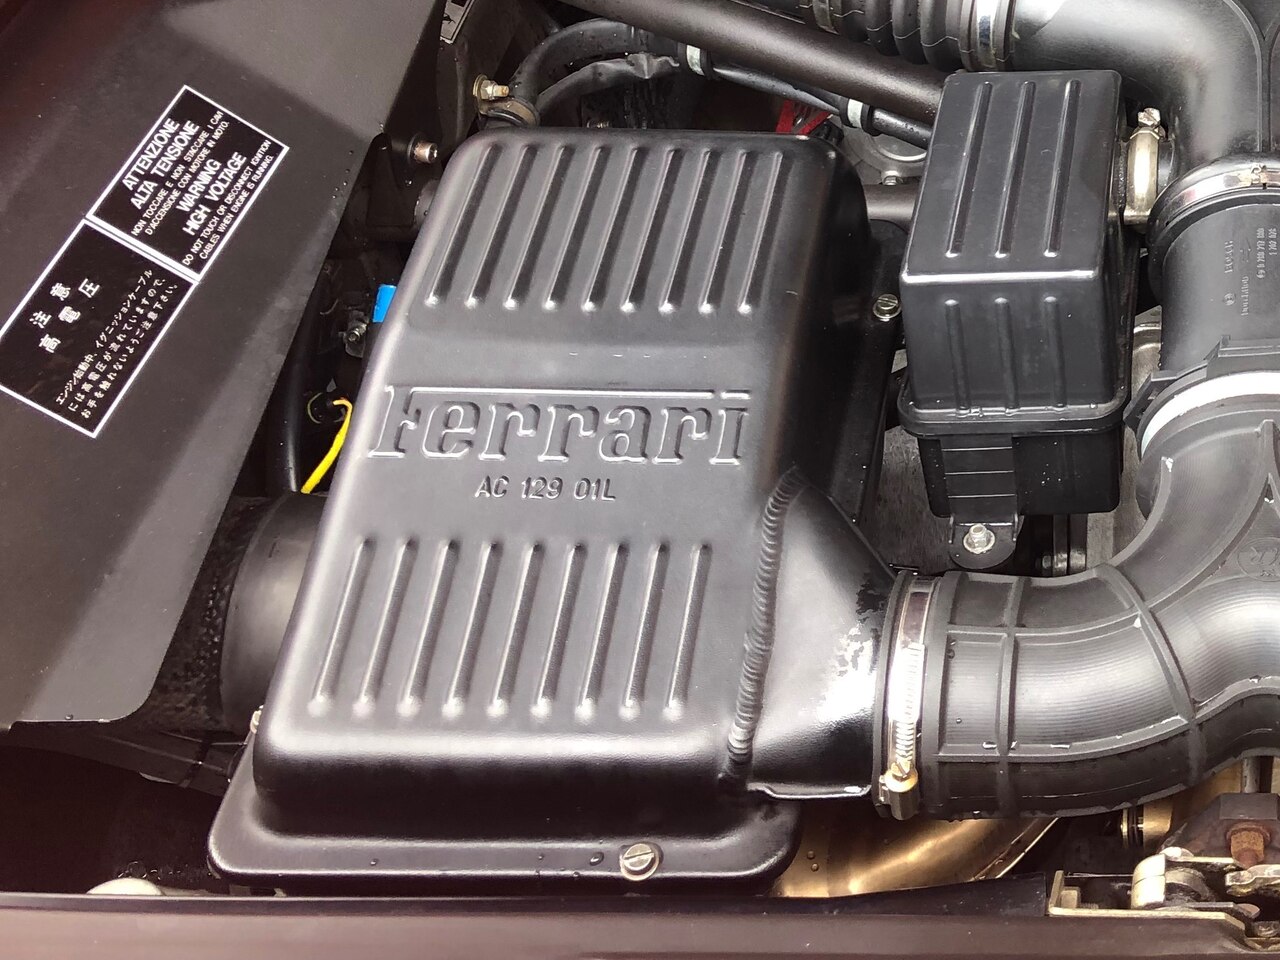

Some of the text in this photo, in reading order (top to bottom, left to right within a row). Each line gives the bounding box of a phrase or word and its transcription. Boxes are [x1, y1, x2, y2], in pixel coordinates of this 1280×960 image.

[122, 118, 180, 190] ATTENZIONE
[130, 120, 200, 210] ALTA TENSIONE
[131, 219, 147, 236] NON
[144, 188, 168, 219] TOCCARE
[165, 180, 174, 188] E
[172, 164, 186, 181] NON
[184, 130, 210, 162] STACCARE
[144, 189, 181, 235] D'ACCENSIONE
[178, 172, 192, 188] CON
[189, 149, 210, 172] MOTORE
[206, 140, 216, 148] IN
[176, 158, 222, 212] WARNING
[182, 152, 247, 236] HIGH VOLTAGE
[182, 140, 272, 266] DO NOT TOUCH OR DISCONNECT IGNITION
[200, 234, 221, 260] CABLES
[217, 213, 234, 233] WHEN
[231, 190, 250, 213] ENGINE
[368, 385, 751, 465] Ferrari
[474, 476, 509, 499] AC
[521, 477, 563, 500] 129
